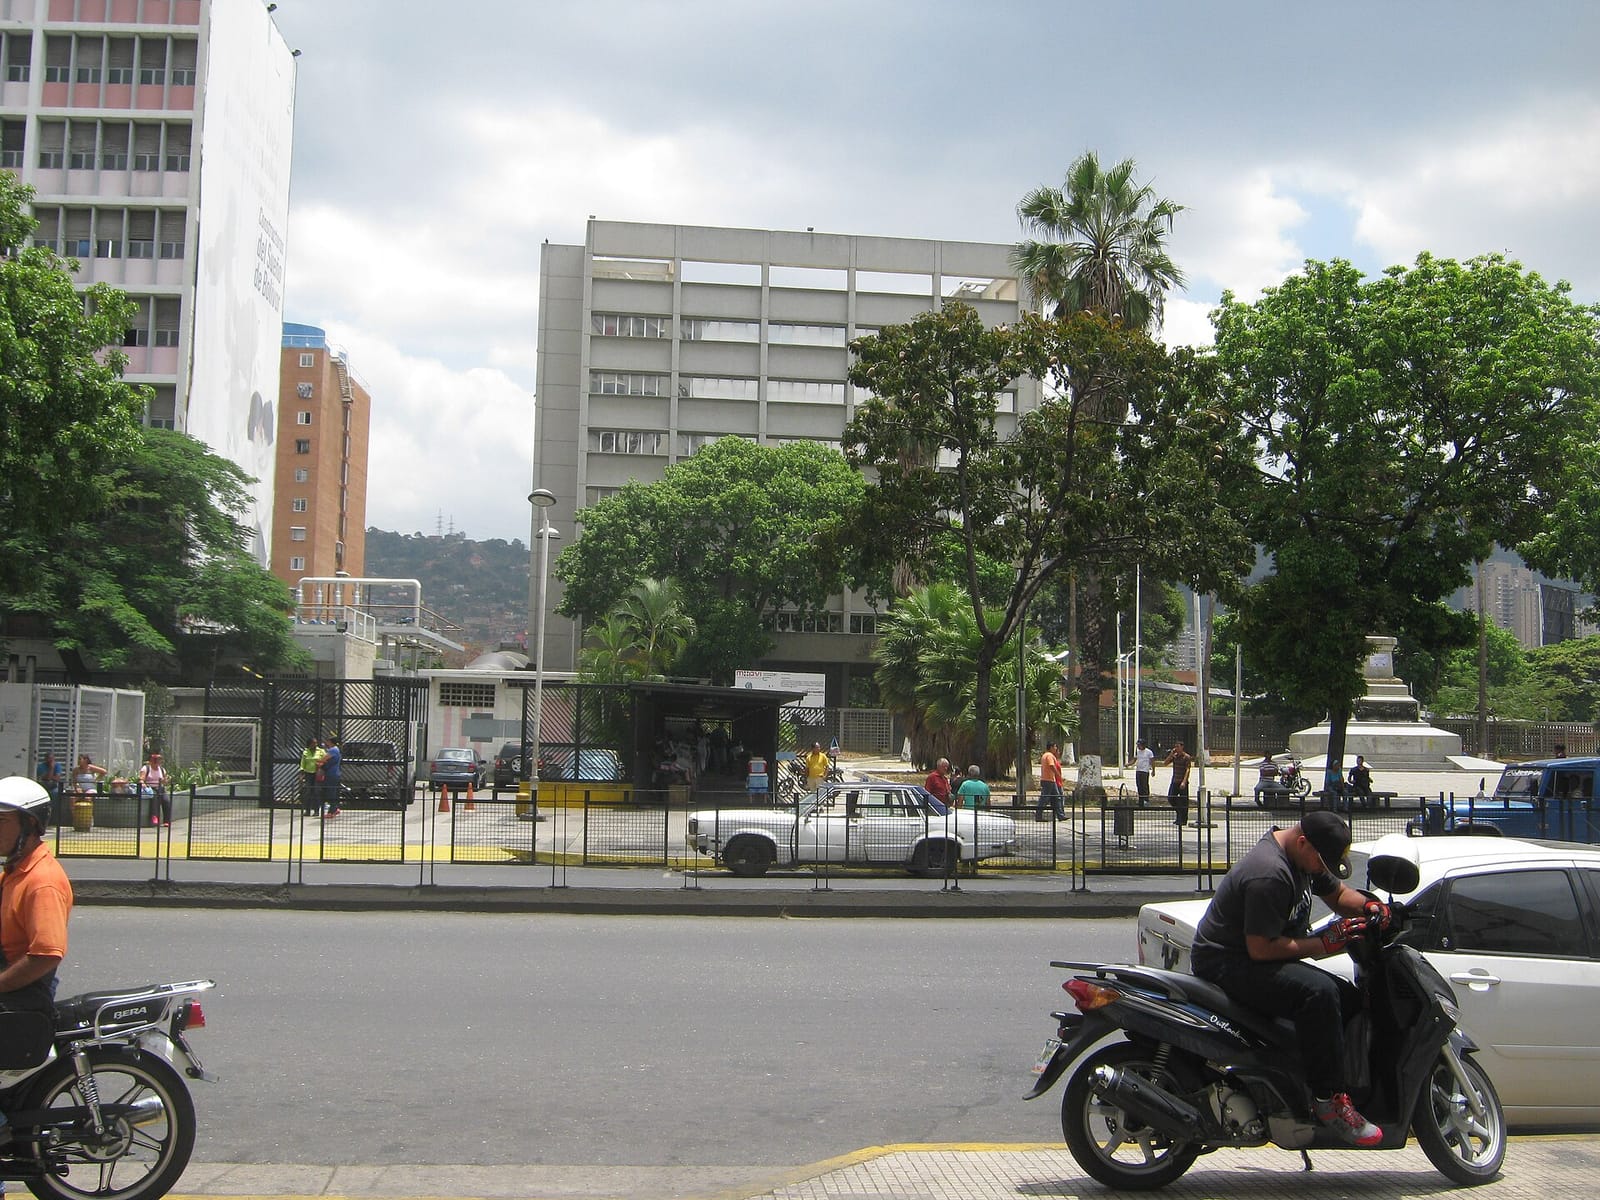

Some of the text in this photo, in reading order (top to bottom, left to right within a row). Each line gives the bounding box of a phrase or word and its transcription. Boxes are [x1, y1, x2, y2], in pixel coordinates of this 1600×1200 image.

[257, 232, 267, 264] del
[254, 264, 262, 291] de
[113, 1006, 147, 1019] BERA
[1210, 1015, 1245, 1041] Outlook
